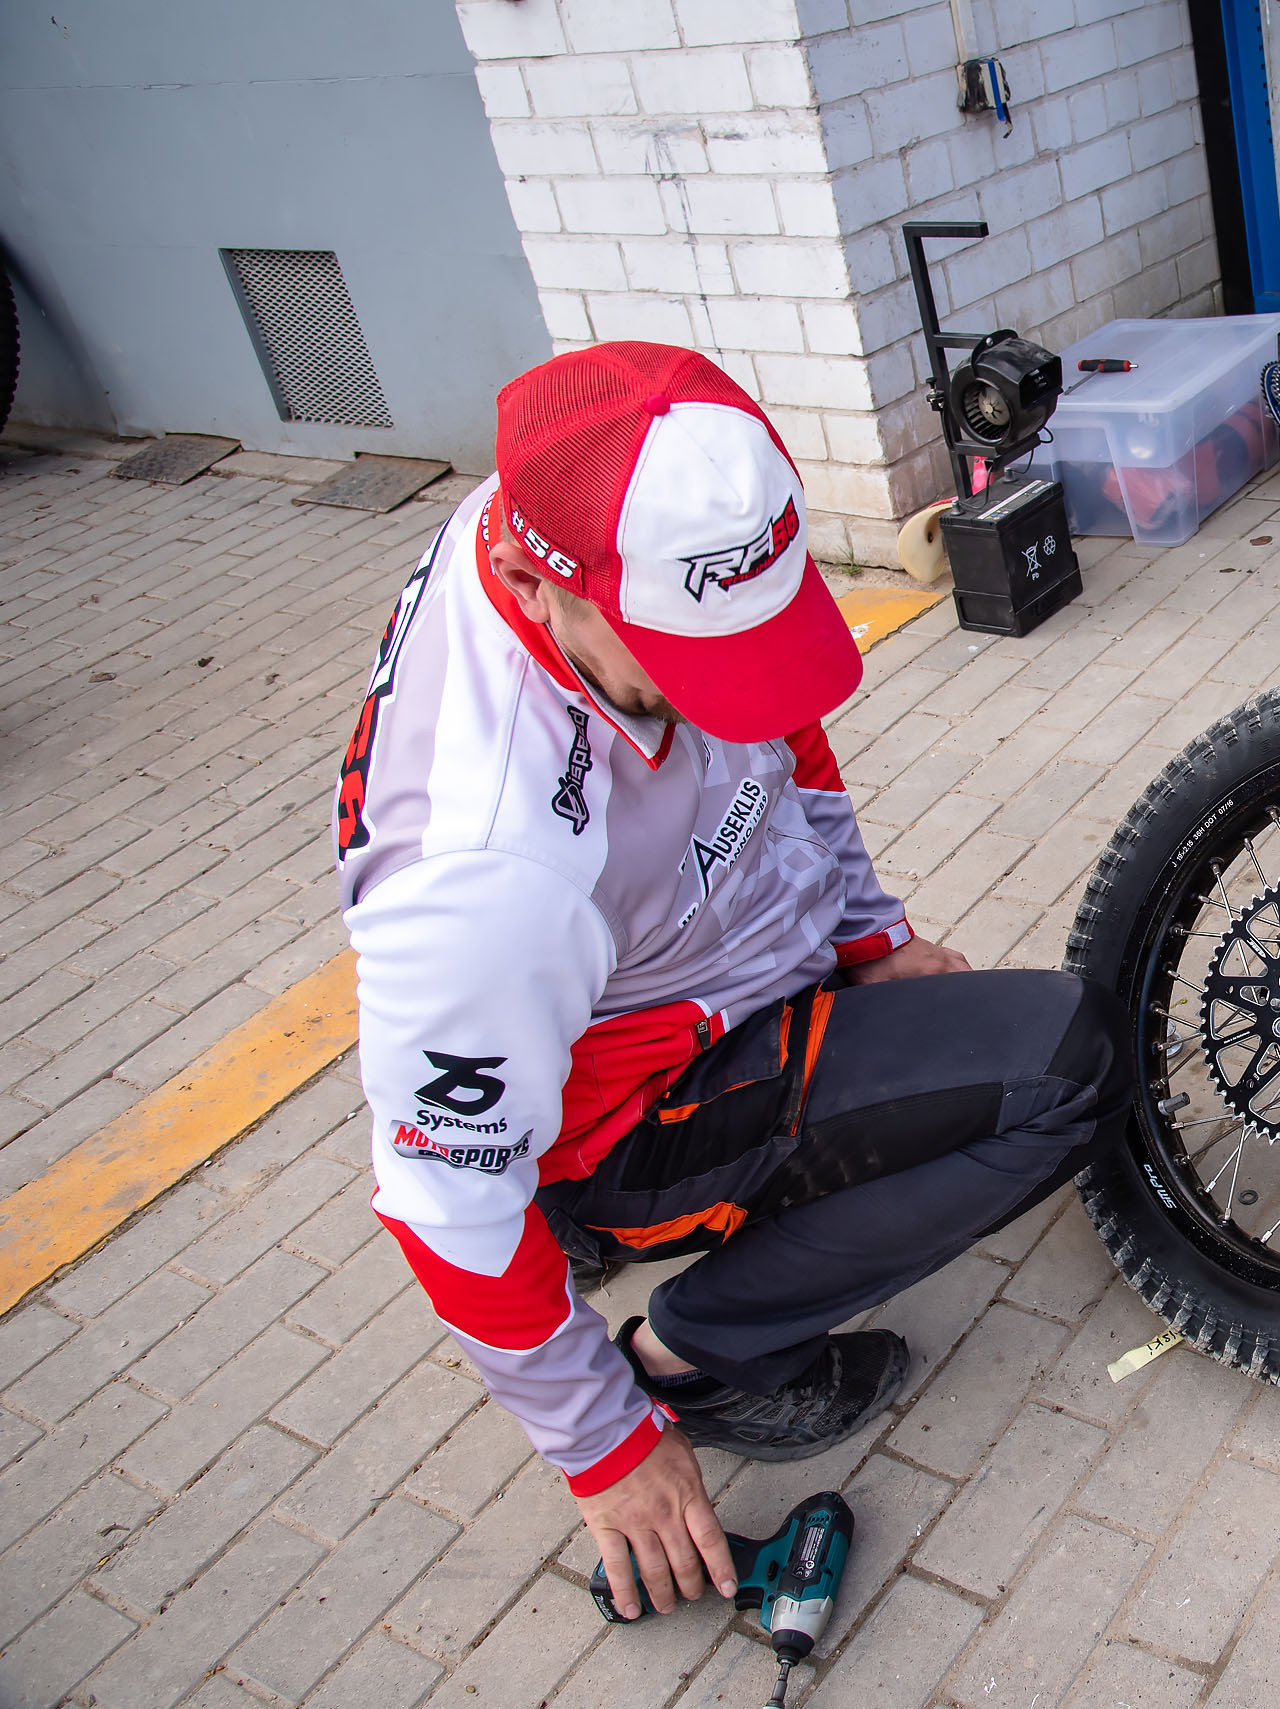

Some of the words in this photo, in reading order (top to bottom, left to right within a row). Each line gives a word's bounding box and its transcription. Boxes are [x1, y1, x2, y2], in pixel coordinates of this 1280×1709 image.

[511, 510, 578, 578] #56
[753, 795, 768, 823] 1989
[1204, 813, 1217, 828] DOT
[692, 780, 762, 902] AUSEKLIS
[416, 1109, 508, 1135] Systems
[1143, 1164, 1164, 1188] Pro
